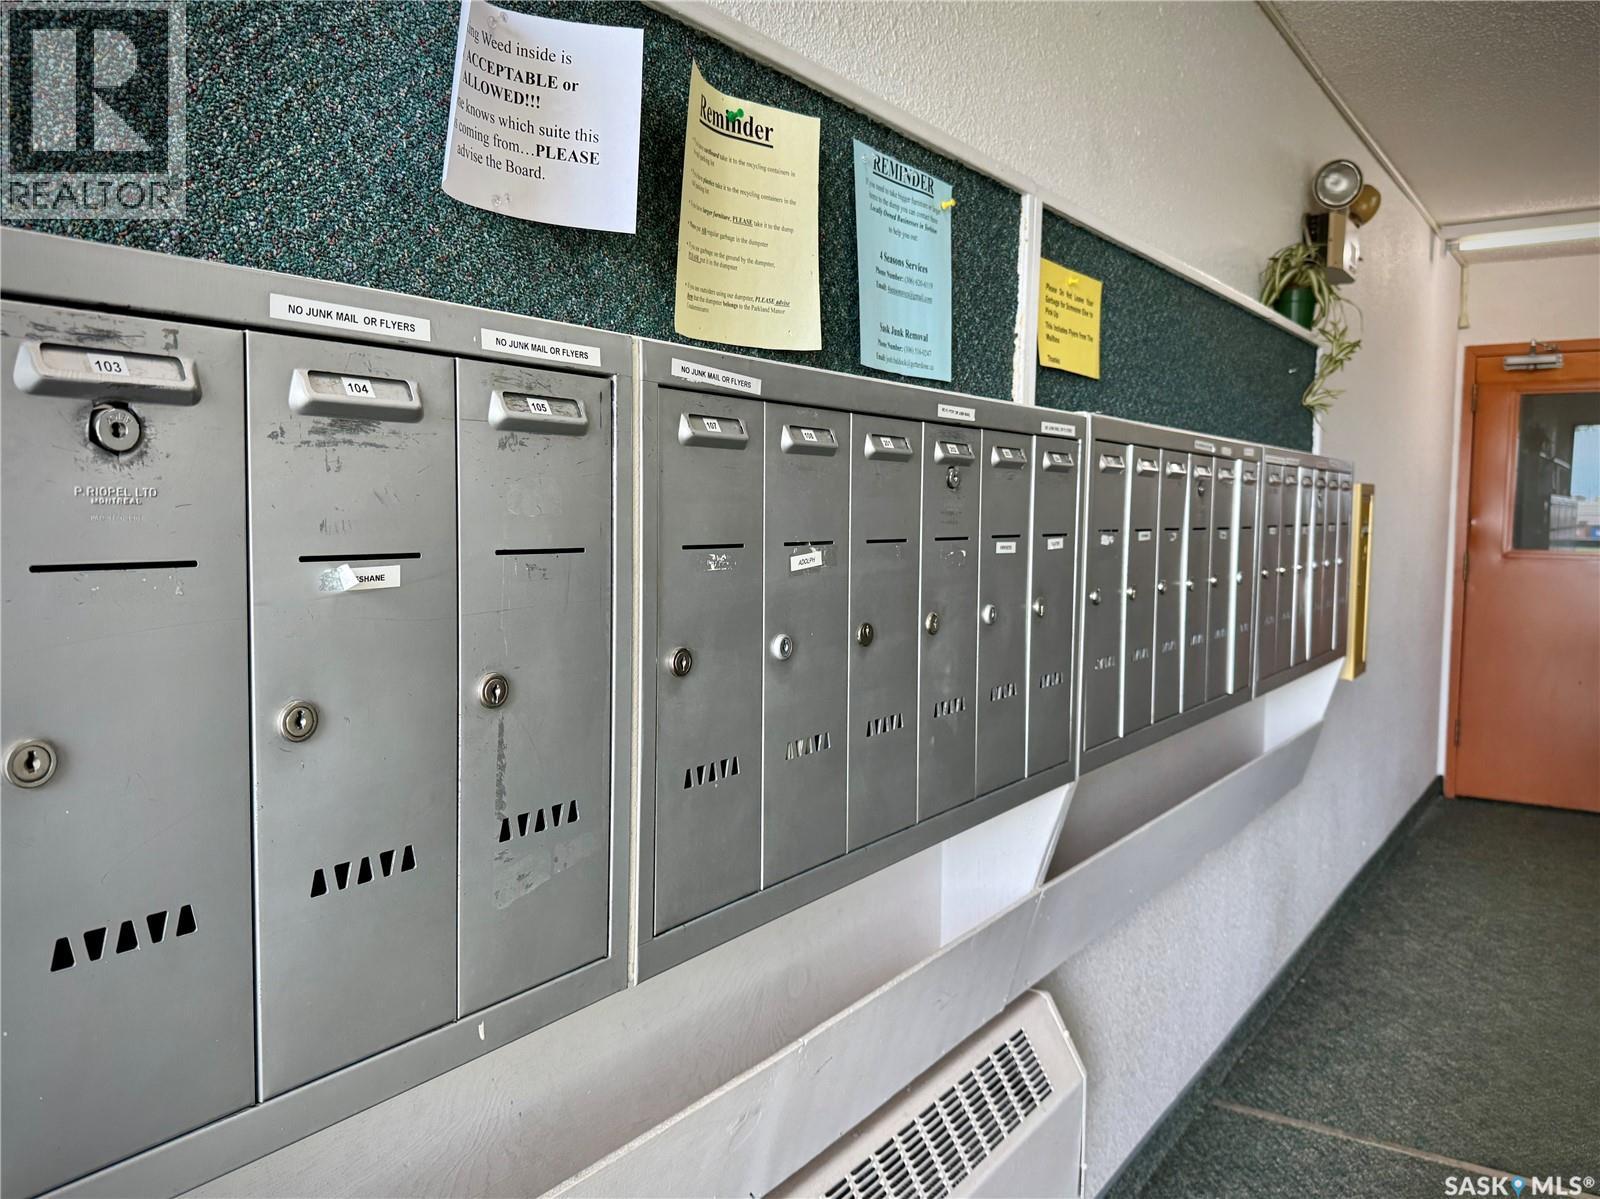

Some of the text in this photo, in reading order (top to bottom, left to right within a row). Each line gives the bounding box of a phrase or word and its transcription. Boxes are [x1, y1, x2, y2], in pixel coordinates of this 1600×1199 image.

[482, 30, 511, 54] Weed
[516, 42, 556, 62] inside
[561, 50, 572, 65] is
[466, 50, 579, 92] ACCEPTABLE or
[463, 70, 540, 109] ALLOWED!!!
[465, 100, 495, 124] knows
[498, 115, 535, 134] which
[538, 125, 571, 140] suite
[575, 129, 600, 143] this
[700, 94, 774, 141] Reminder
[458, 123, 490, 147] coming
[457, 143, 545, 180] advise the Board.
[873, 154, 934, 197] REMINDER
[732, 216, 753, 227] PLEASE
[884, 251, 904, 267] Seasons
[905, 259, 928, 273] Services
[755, 296, 775, 305] PLEASE
[288, 304, 416, 332] NO JUNK MAIL OR FLYERS
[905, 328, 928, 342] Removal
[495, 337, 589, 359] NO JUNK MAIL OR FLYERS
[94, 360, 122, 373] 103
[681, 365, 751, 389] NO JUNK MAIL OR FLYERS
[347, 382, 368, 394] 104
[531, 403, 547, 412] 105
[706, 421, 717, 430] 107
[91, 497, 142, 505] MONTREAL
[135, 487, 158, 497] LTD
